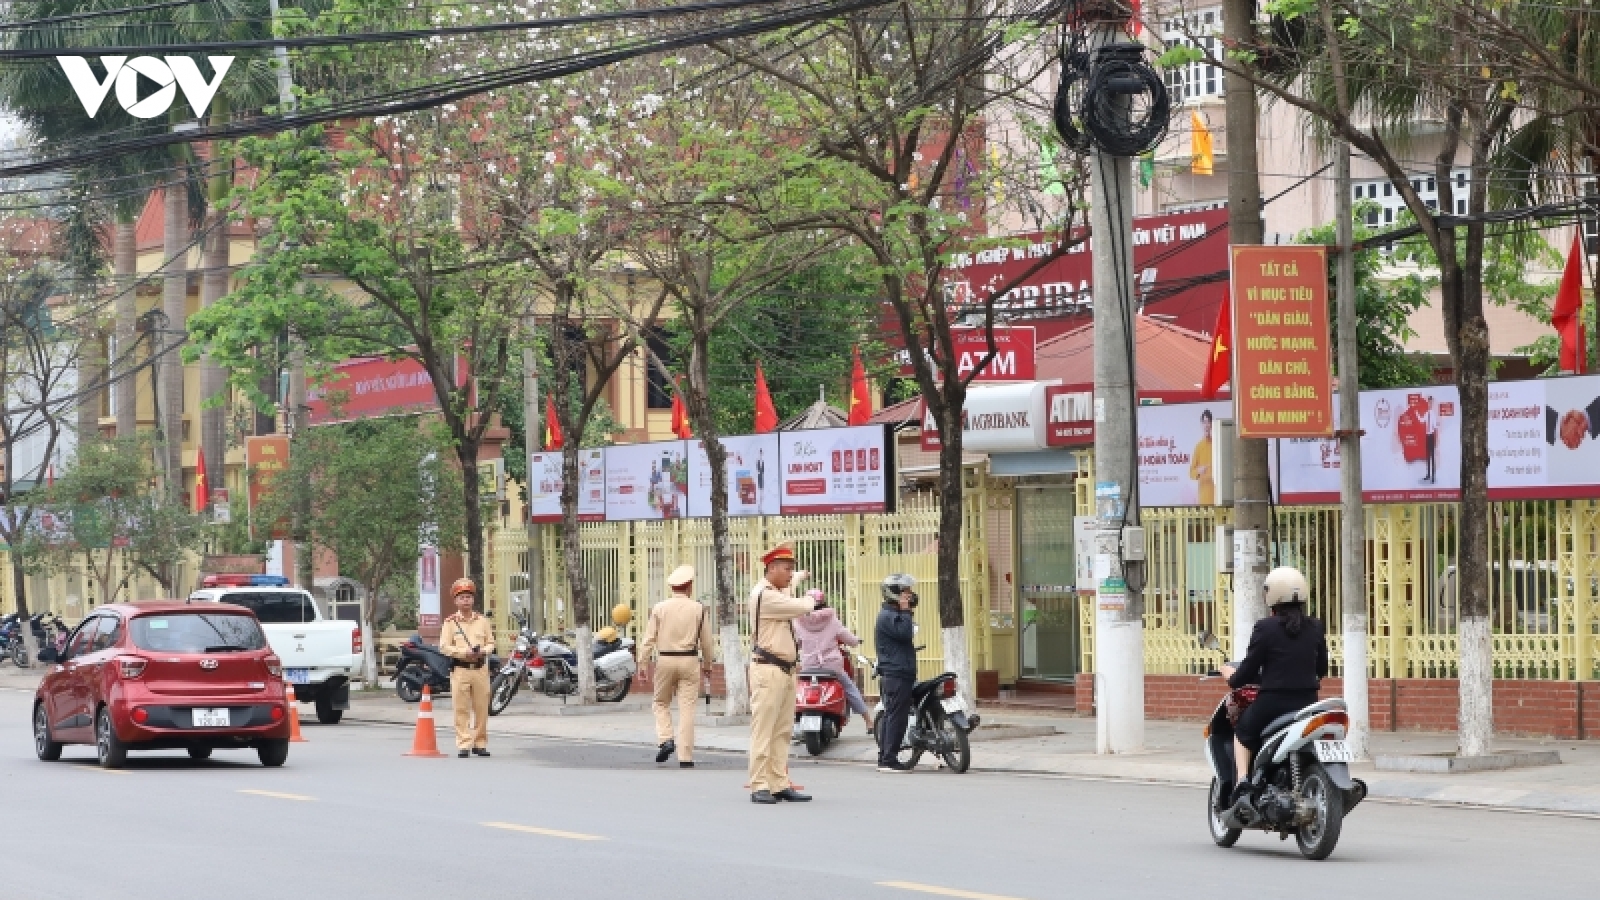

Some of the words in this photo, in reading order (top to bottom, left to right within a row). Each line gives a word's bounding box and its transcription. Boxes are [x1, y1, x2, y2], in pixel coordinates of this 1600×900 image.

[1153, 222, 1176, 245] VIỆT
[1180, 221, 1207, 241] NAM
[1261, 261, 1280, 277] TẤT
[1284, 261, 1299, 277] CẢ
[1247, 286, 1258, 301] VÌ
[1262, 287, 1286, 305] MỤC
[1290, 286, 1313, 301] TIÊU
[1247, 335, 1278, 352] NƯỚC
[957, 351, 1016, 377] ATM
[1259, 360, 1282, 376] DÂN
[1286, 359, 1311, 377] CHỦ,
[1251, 384, 1280, 400] CÔNG
[972, 410, 1031, 432] AGRIBANK
[1050, 392, 1093, 424] ATM
[1252, 409, 1275, 424] VĂN
